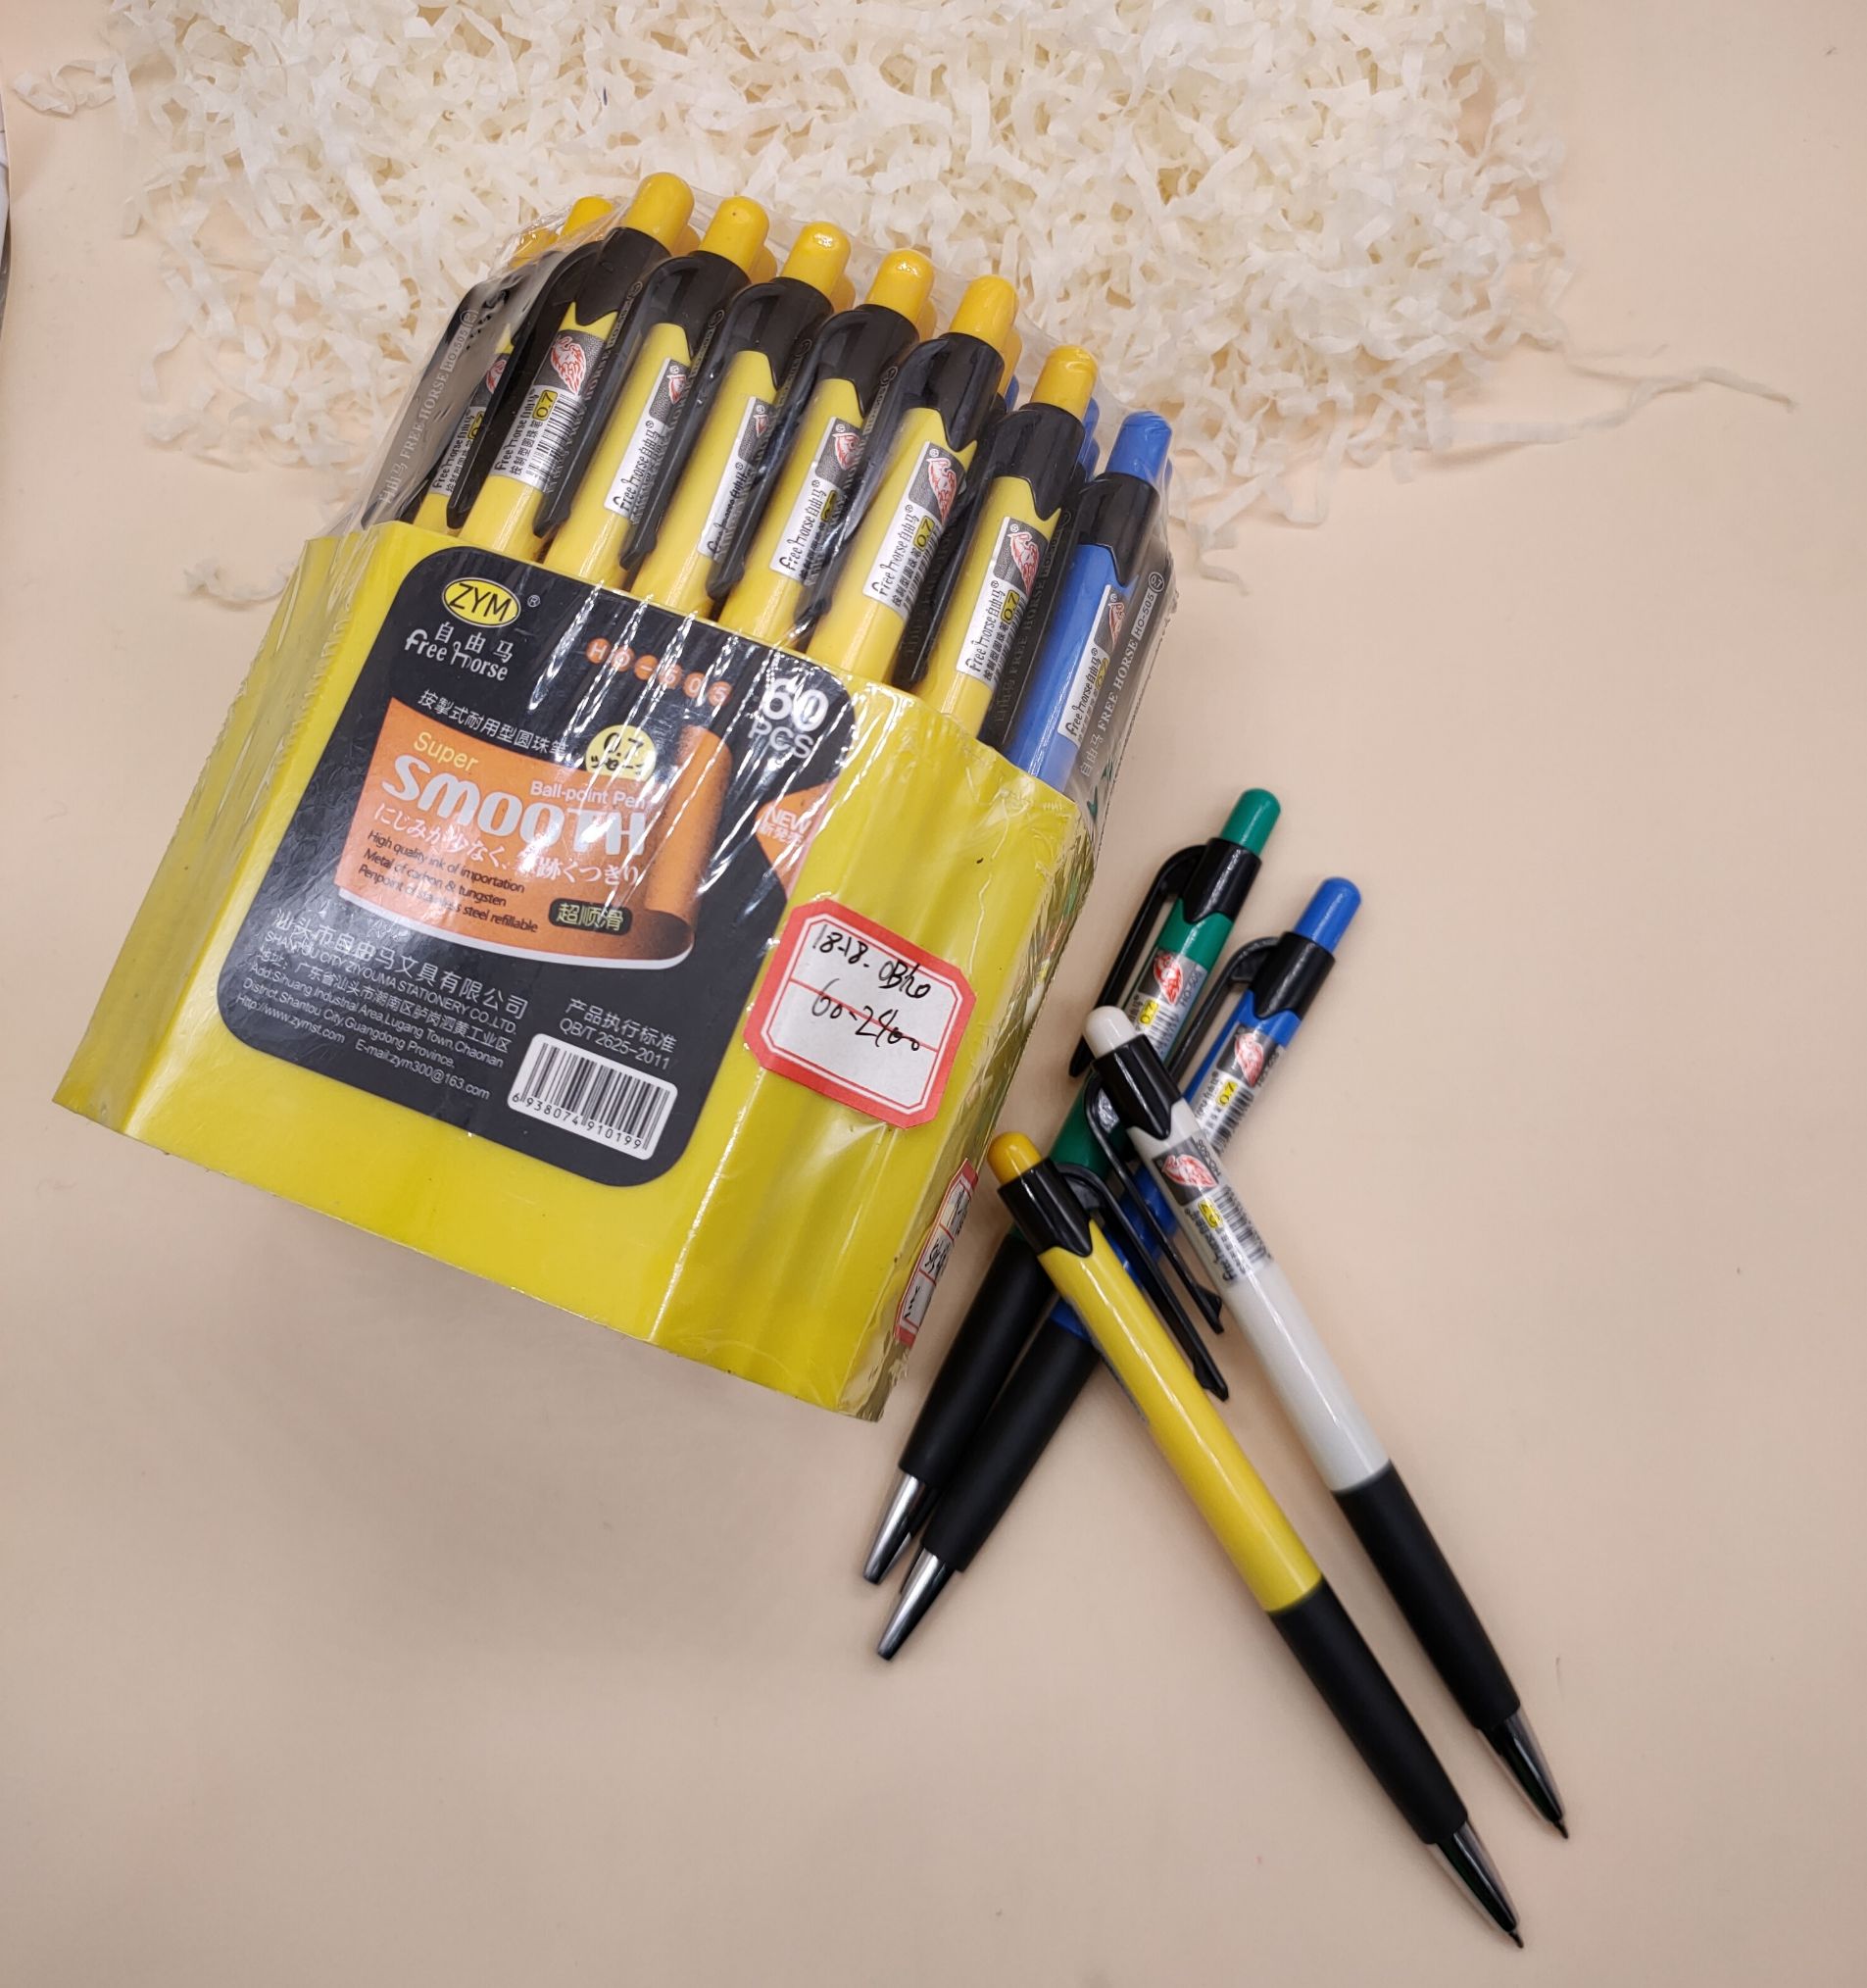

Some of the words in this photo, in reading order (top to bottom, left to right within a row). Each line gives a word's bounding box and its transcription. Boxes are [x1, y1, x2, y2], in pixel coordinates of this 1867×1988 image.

[400, 422, 425, 460] FREE
[418, 372, 449, 423] HORSE
[535, 392, 555, 420] 0.7
[917, 521, 934, 548] 0.7
[449, 582, 513, 622] ZYM
[1005, 592, 1020, 621] 0.7
[434, 621, 515, 664] 自由马
[1097, 692, 1119, 733] FREE
[1112, 637, 1140, 693] HORSE
[1134, 593, 1155, 637] HO-505
[762, 677, 830, 733] 60
[1065, 711, 1083, 737] Free
[413, 730, 479, 772] Super
[603, 731, 644, 760] 0.7
[748, 719, 814, 759] PCS
[529, 779, 608, 806] Ball-point
[611, 789, 647, 811] Pen
[762, 805, 812, 834] NEW
[364, 849, 395, 870] Metal
[394, 864, 408, 873] of
[407, 869, 443, 887] carbon
[445, 879, 457, 893] &
[459, 885, 507, 907] tungsten
[368, 829, 393, 849] High
[393, 843, 424, 863] quality
[429, 857, 444, 869] ink
[447, 864, 460, 873] of
[461, 866, 524, 893] importation
[358, 864, 404, 891] Penpoint
[463, 906, 490, 920] steel
[491, 914, 538, 933] refillable
[557, 902, 624, 931] 超顺滑
[266, 931, 320, 959] SHANTOU
[319, 951, 346, 968] CITY
[345, 960, 396, 988] ZIYOUMA
[398, 980, 470, 1016] STATIONERY
[271, 908, 529, 1019] 汕头市自由马文具有限公司
[314, 986, 359, 1013] Industrial
[1140, 1000, 1156, 1024] 0.7
[559, 1018, 597, 1040] QB/T
[595, 1031, 671, 1070] 2625-2011
[565, 997, 678, 1054] 产品执行标准
[1218, 1080, 1236, 1106] 0.7
[512, 1092, 520, 1104] 6
[526, 1097, 579, 1126] 938074
[587, 1120, 642, 1150] 910199
[1198, 1138, 1222, 1177] HO-505
